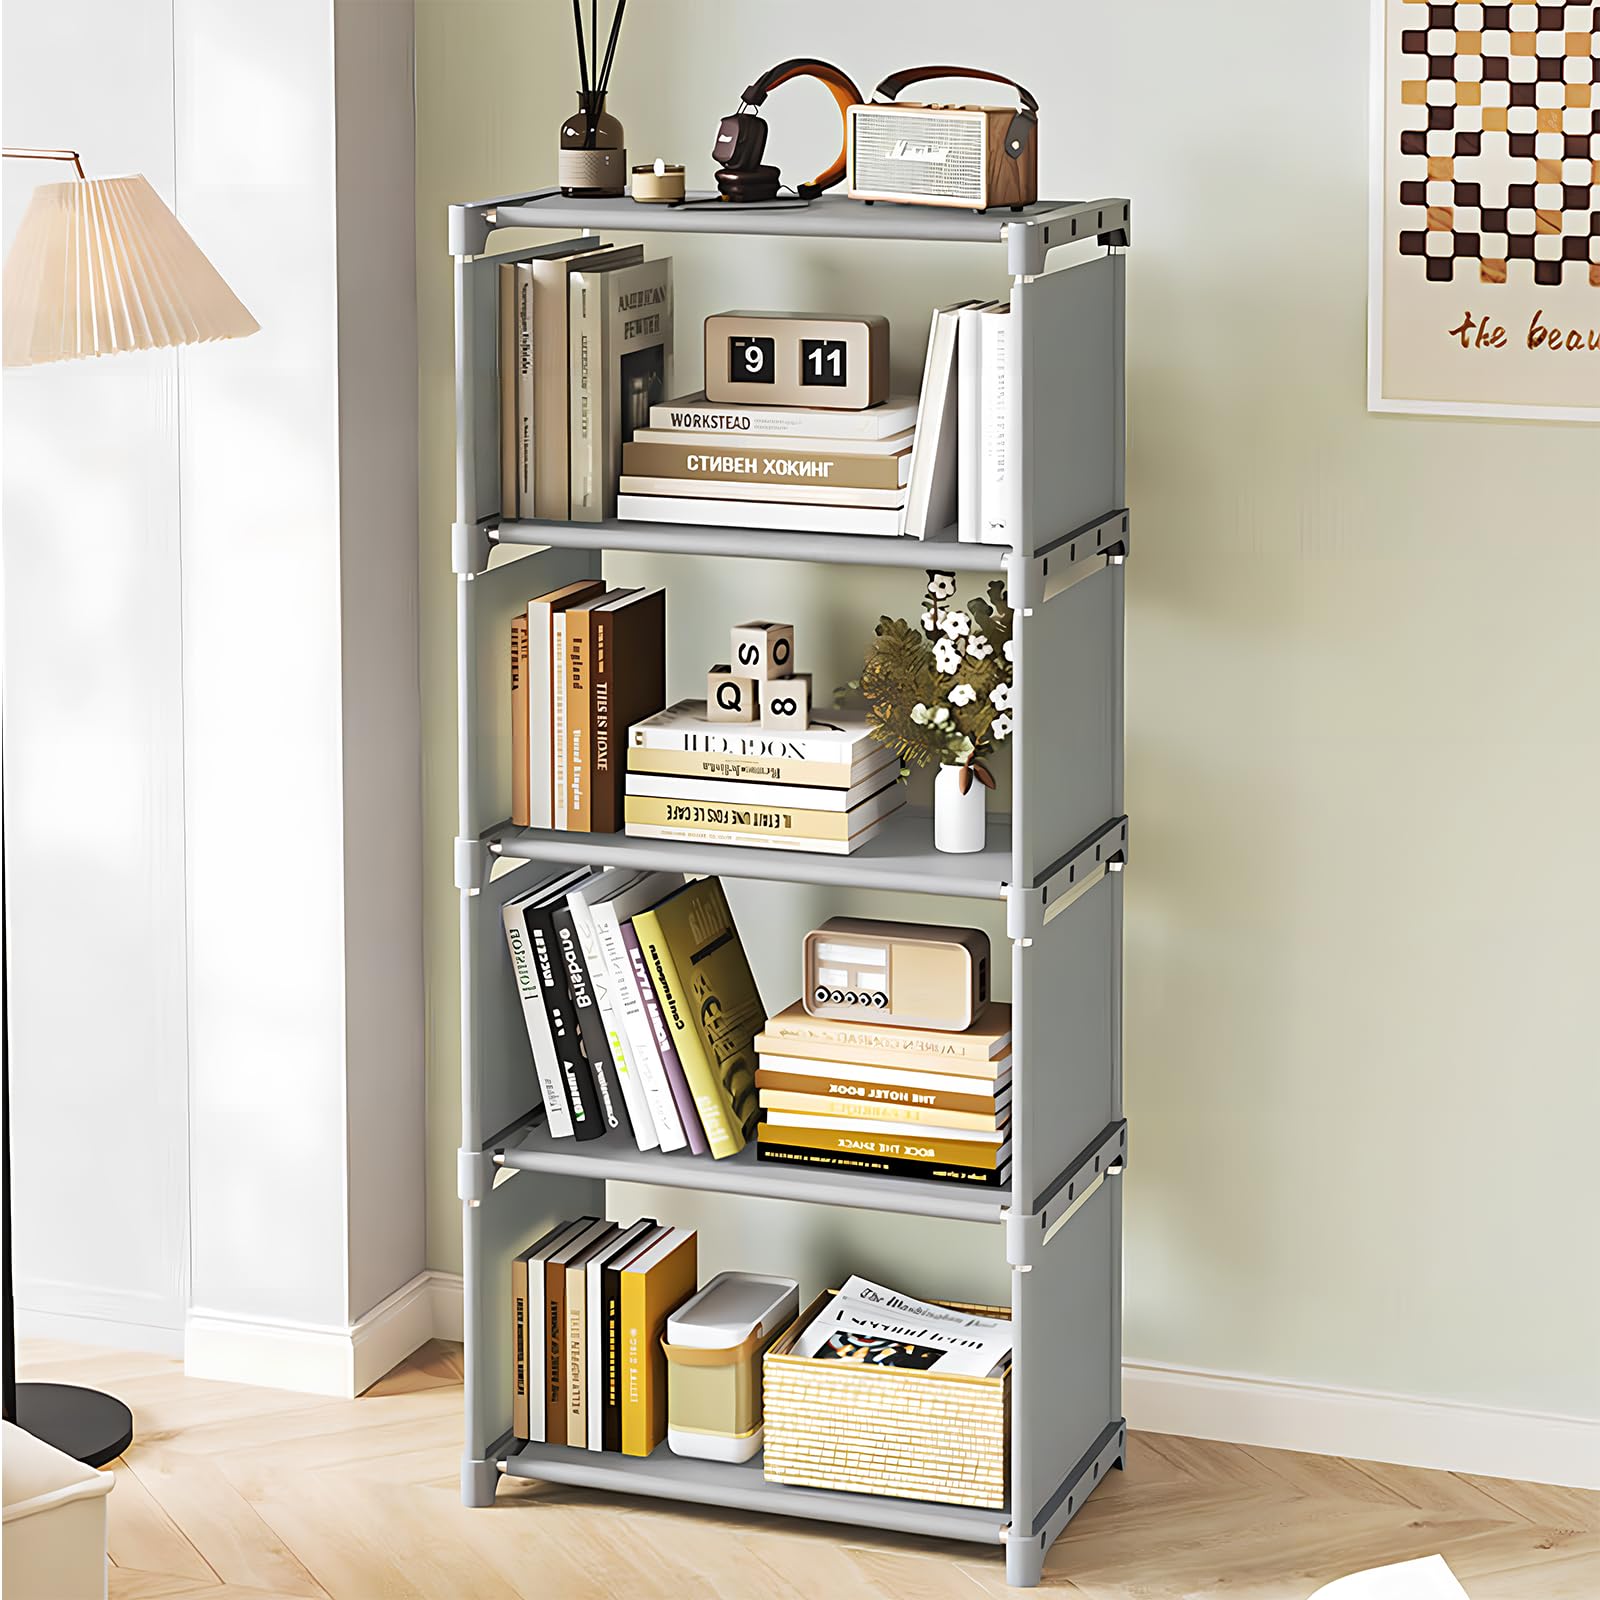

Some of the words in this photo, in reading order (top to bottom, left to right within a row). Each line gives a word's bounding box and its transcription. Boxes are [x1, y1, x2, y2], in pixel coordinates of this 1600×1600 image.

[1448, 310, 1508, 349] the
[744, 346, 764, 373] 9
[808, 348, 841, 376] 11
[671, 412, 751, 430] WORKSTEAD
[687, 455, 757, 474] СТИВЕН
[763, 459, 834, 477] ХОКИНГ
[716, 682, 741, 712] Q
